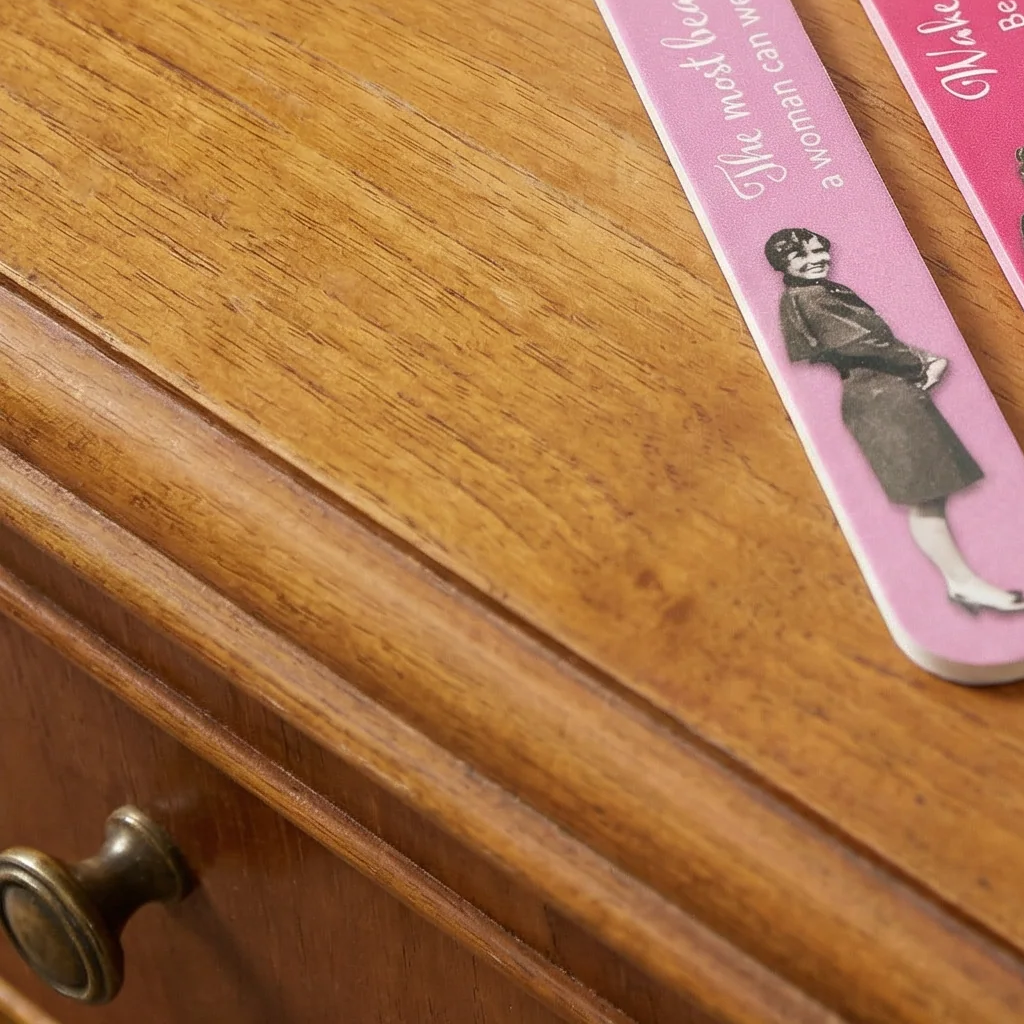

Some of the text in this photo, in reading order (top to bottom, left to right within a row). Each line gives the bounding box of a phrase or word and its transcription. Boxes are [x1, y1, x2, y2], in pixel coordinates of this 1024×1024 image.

[679, 52, 751, 120] most
[749, 32, 784, 72] can
[773, 79, 834, 169] woman
[714, 128, 787, 200] The
[821, 174, 844, 189] a
